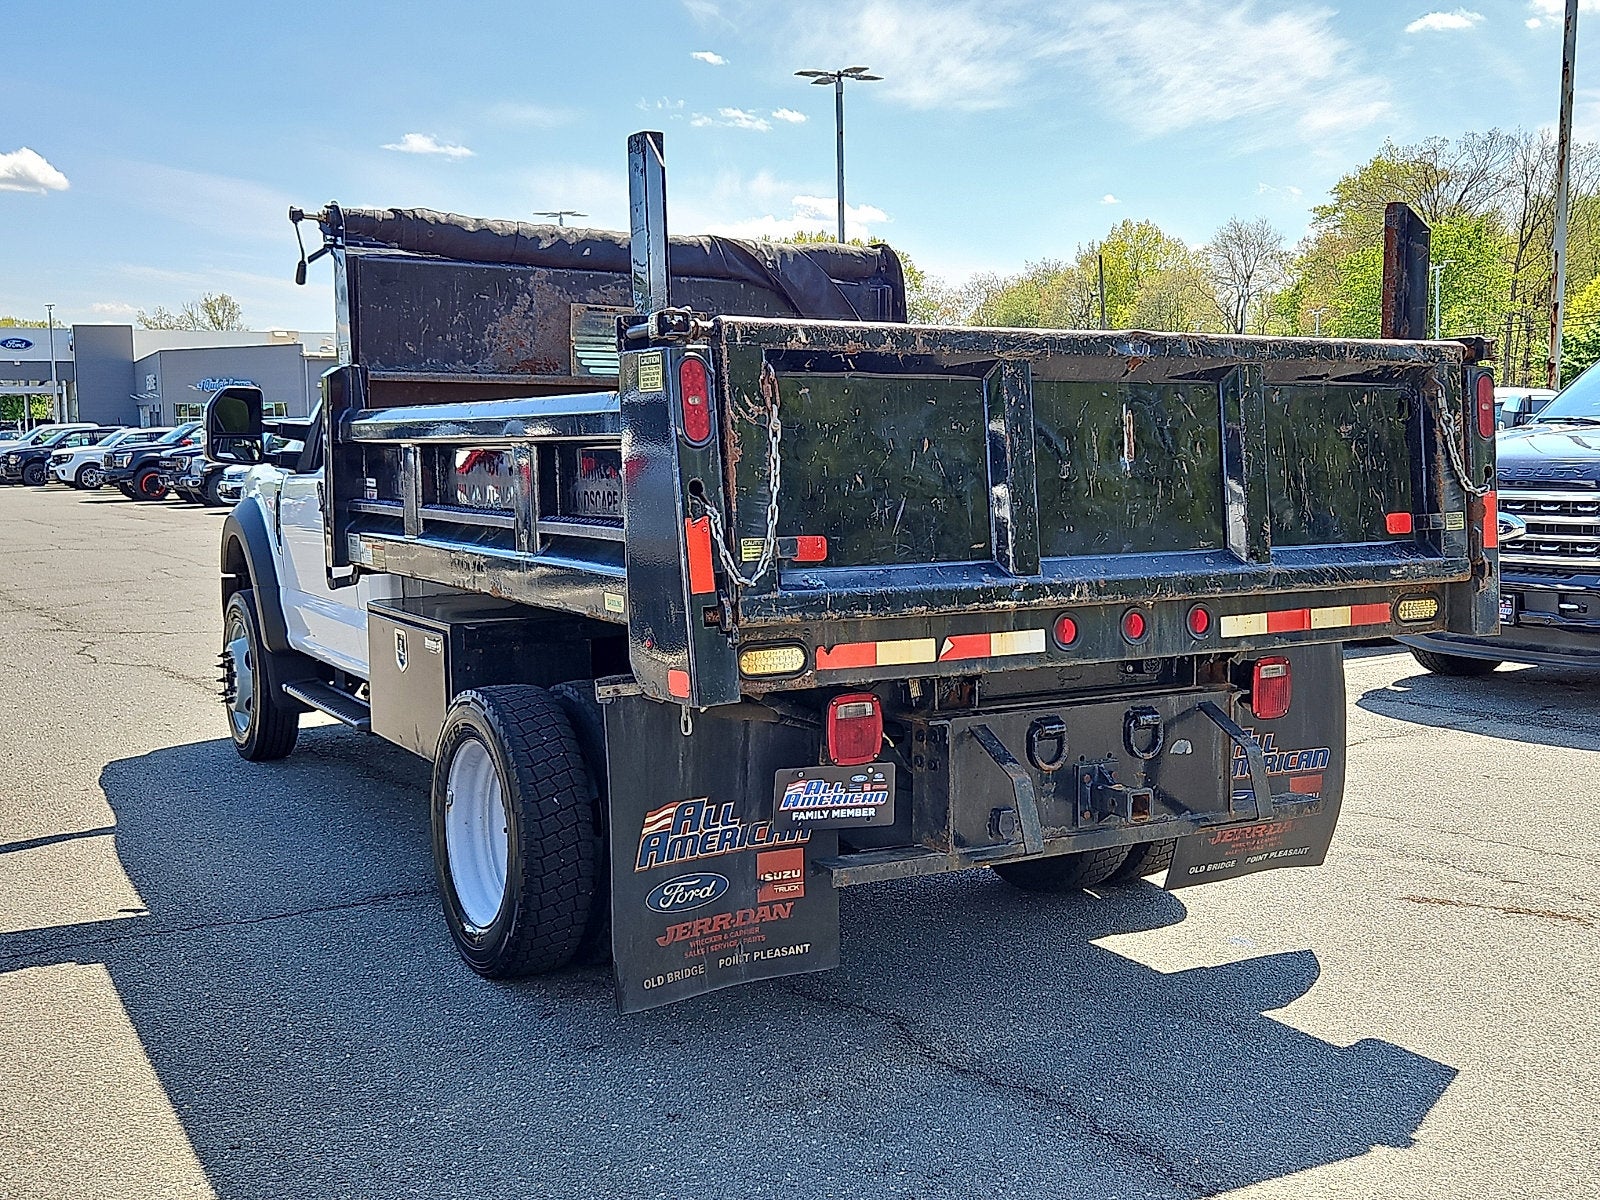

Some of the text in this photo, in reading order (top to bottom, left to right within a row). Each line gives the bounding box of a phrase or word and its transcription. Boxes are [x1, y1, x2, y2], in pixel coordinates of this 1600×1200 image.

[6, 339, 26, 348] Ford
[1515, 467, 1592, 477] DUTY
[804, 780, 846, 795] ALL
[779, 791, 889, 811] AMERICAN
[671, 797, 740, 836] ALL
[792, 808, 876, 821] FAMILY MEMBER
[1188, 865, 1205, 875] OLD
[1206, 859, 1237, 872] BRIDGE
[1246, 853, 1268, 865] POINT
[1269, 846, 1310, 860] PLEASANT
[760, 869, 801, 881] ISUZU
[660, 878, 717, 907] Ford
[774, 884, 800, 893] TRUCK
[643, 975, 664, 990] OLD
[667, 964, 705, 983] BRIDGE
[753, 943, 811, 962] PLEASANT
